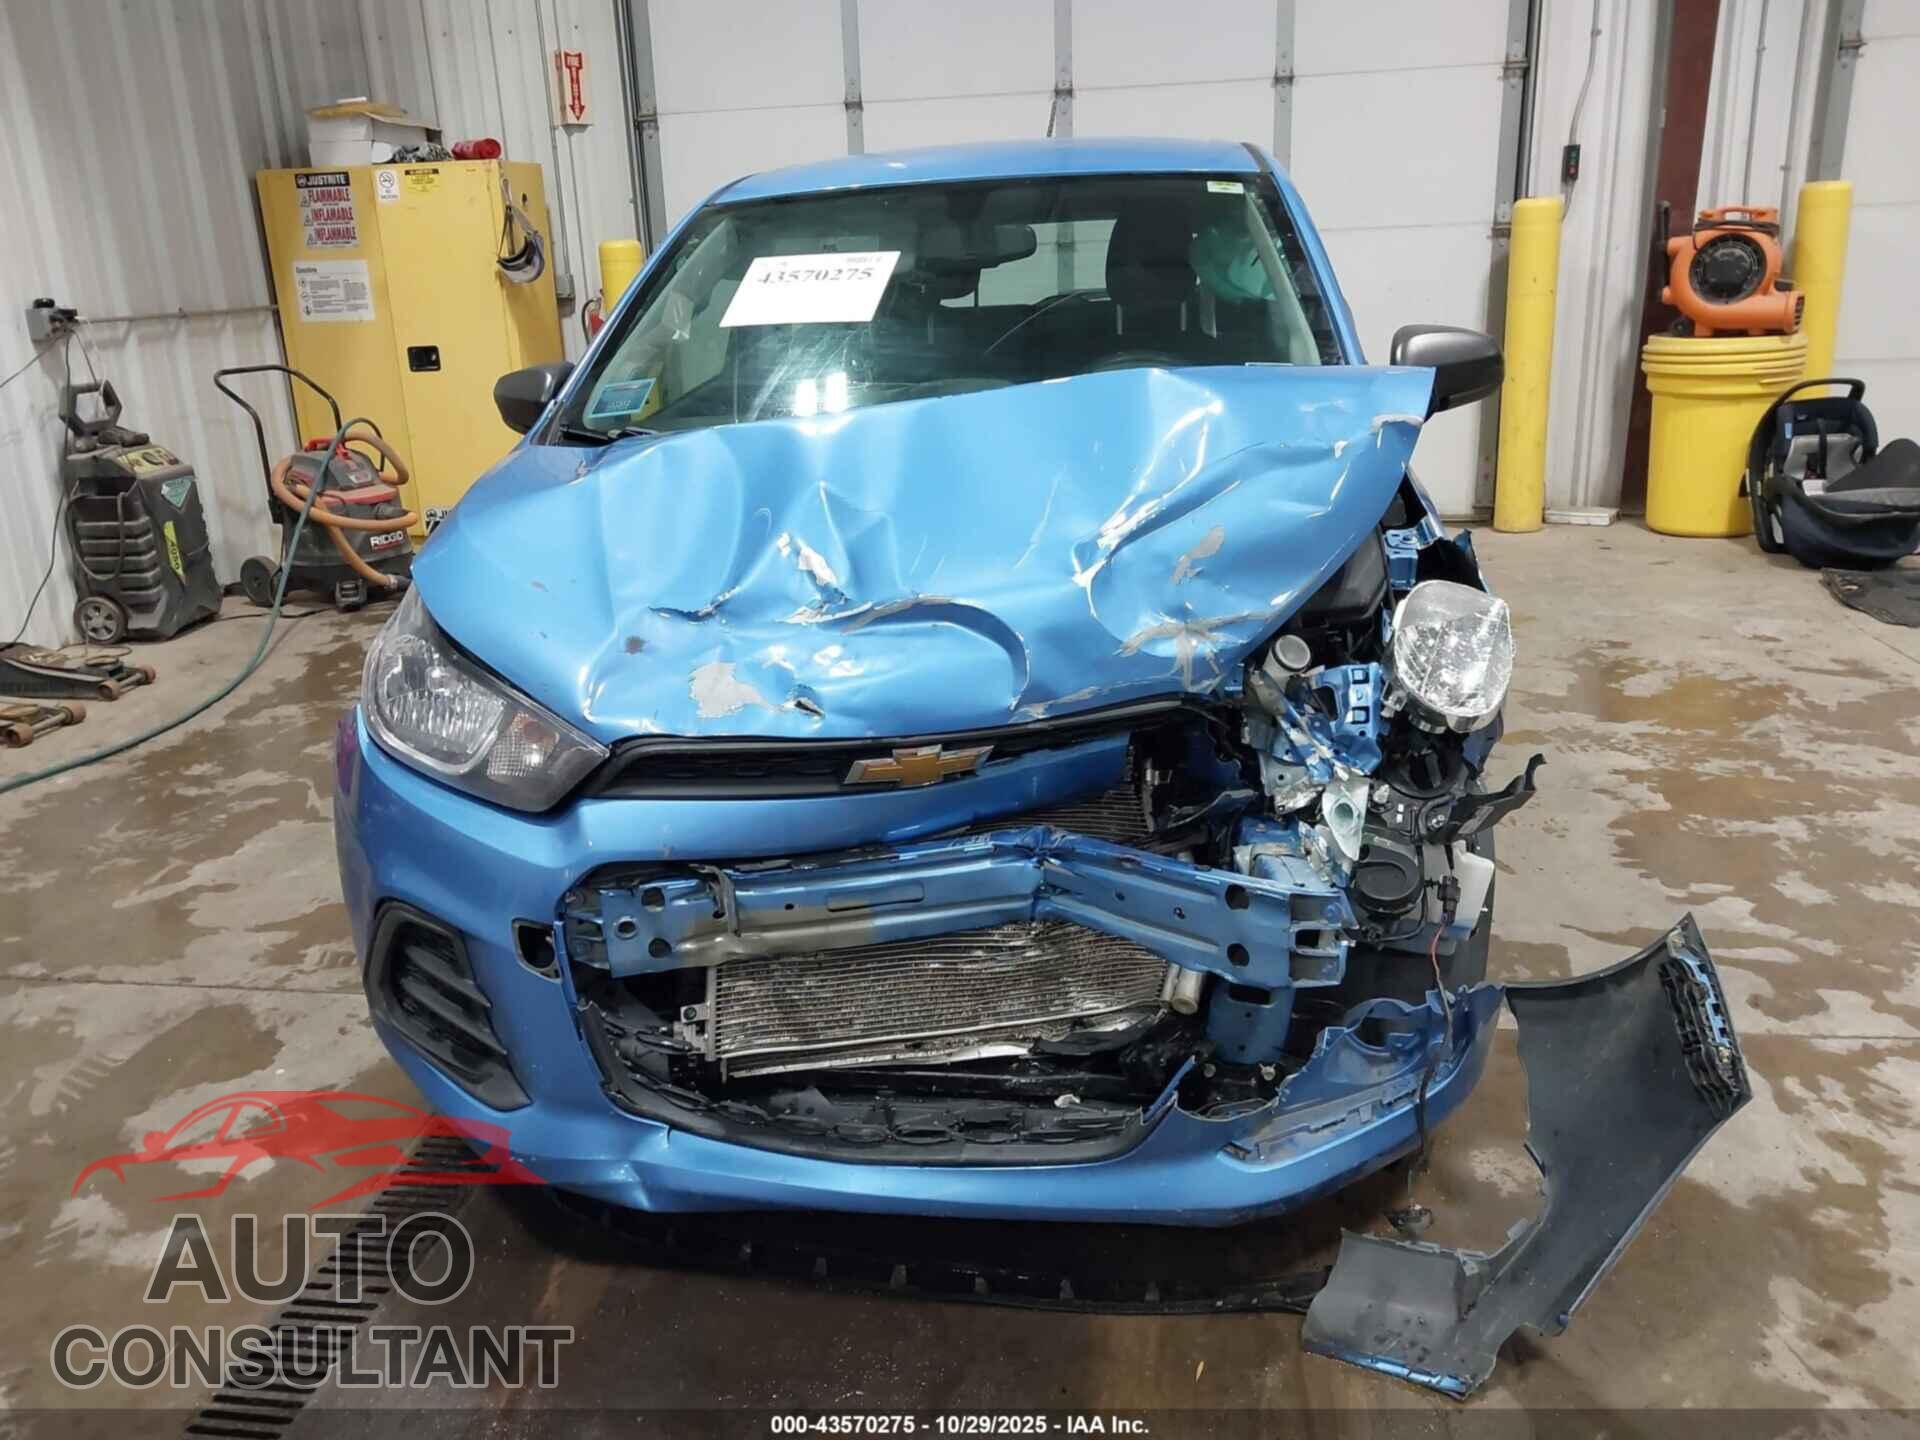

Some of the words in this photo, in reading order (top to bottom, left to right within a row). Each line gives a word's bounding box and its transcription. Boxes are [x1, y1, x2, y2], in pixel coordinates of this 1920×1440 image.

[307, 174, 346, 186] JUSTRITE
[308, 188, 351, 203] FLAMMABLE
[311, 207, 354, 222] INFLAMABLE
